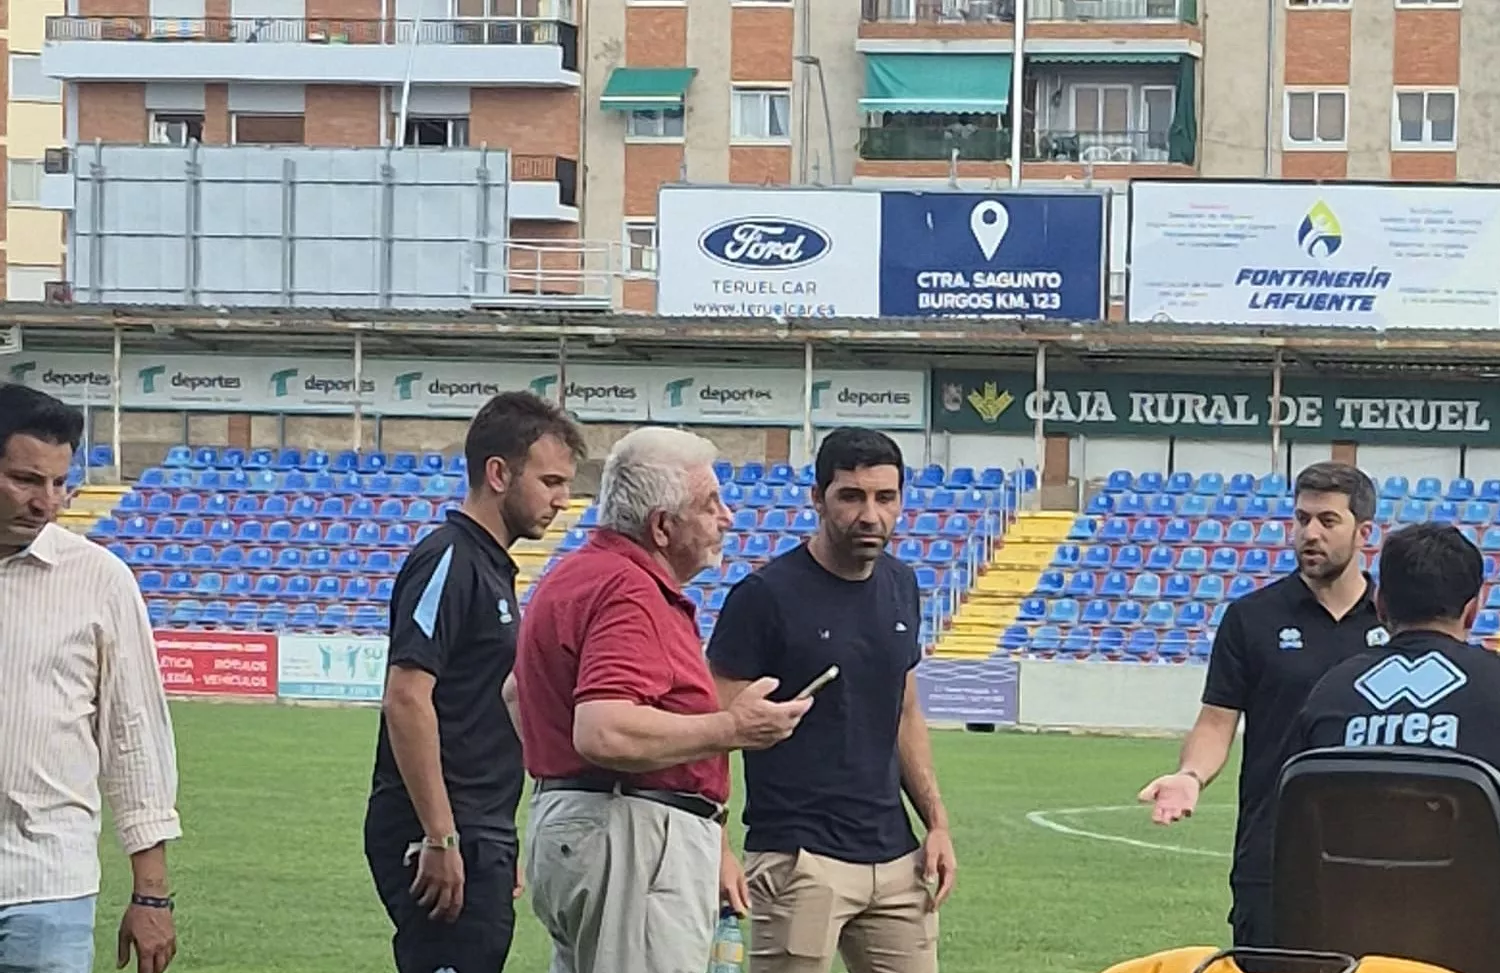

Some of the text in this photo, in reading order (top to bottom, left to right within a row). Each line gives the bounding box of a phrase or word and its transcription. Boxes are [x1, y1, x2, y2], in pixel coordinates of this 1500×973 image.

[724, 222, 804, 262] Ford
[712, 279, 817, 295] TERUEL CAR
[917, 271, 1062, 289] CTRA. SAGUNTO
[1235, 265, 1392, 290] FONTANERÍA
[918, 292, 1061, 310] BURGOS KM. 123
[1247, 291, 1377, 313] LAFUENTE
[42, 369, 112, 387] deportes
[171, 372, 242, 390] deportes
[565, 382, 637, 401] deportes
[837, 387, 911, 407] deportes
[1025, 390, 1490, 431] CAJA RURAL DE TERUEL
[1344, 712, 1460, 749] errea
